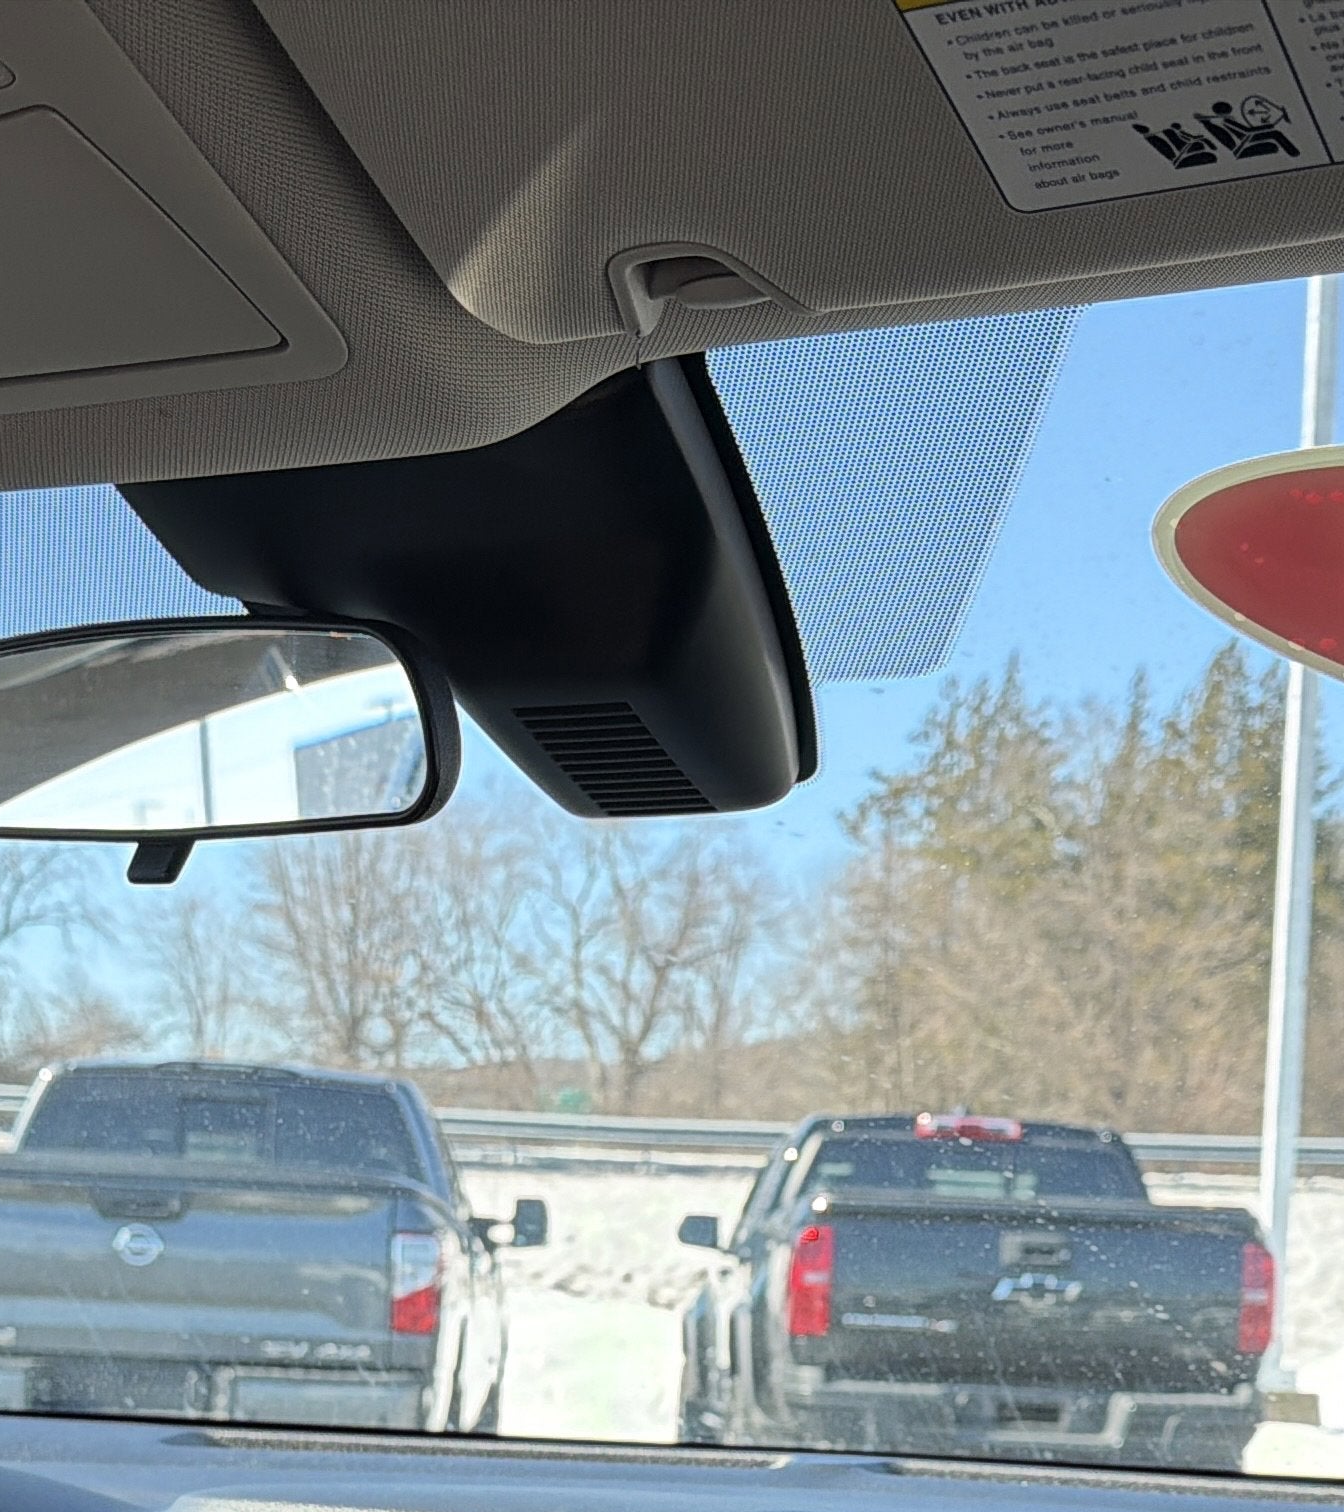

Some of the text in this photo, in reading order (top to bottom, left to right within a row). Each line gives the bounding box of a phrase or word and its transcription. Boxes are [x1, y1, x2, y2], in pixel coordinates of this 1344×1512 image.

[935, 8, 982, 25] EVEN
[984, 1, 1029, 15] WITH
[956, 29, 1010, 46] Children
[1014, 24, 1038, 35] can
[1041, 19, 1059, 29] be
[1062, 11, 1098, 26] killed
[1102, 9, 1116, 19] or
[964, 37, 1054, 62] by the air bag
[974, 23, 1254, 80] The back seat is the safest place for children
[985, 87, 1022, 99] Never
[1027, 83, 1045, 95] put
[1128, 61, 1157, 75] child
[1161, 56, 1189, 69] seat
[1191, 52, 1205, 64] in
[1207, 49, 1229, 60] the
[1231, 43, 1262, 56] front
[997, 65, 1272, 121] Always use seat belts and child restraints
[1007, 110, 1138, 141] See owner's manual
[1020, 140, 1074, 157] for more
[1028, 153, 1100, 173] information
[1035, 167, 1120, 190] about air bags
